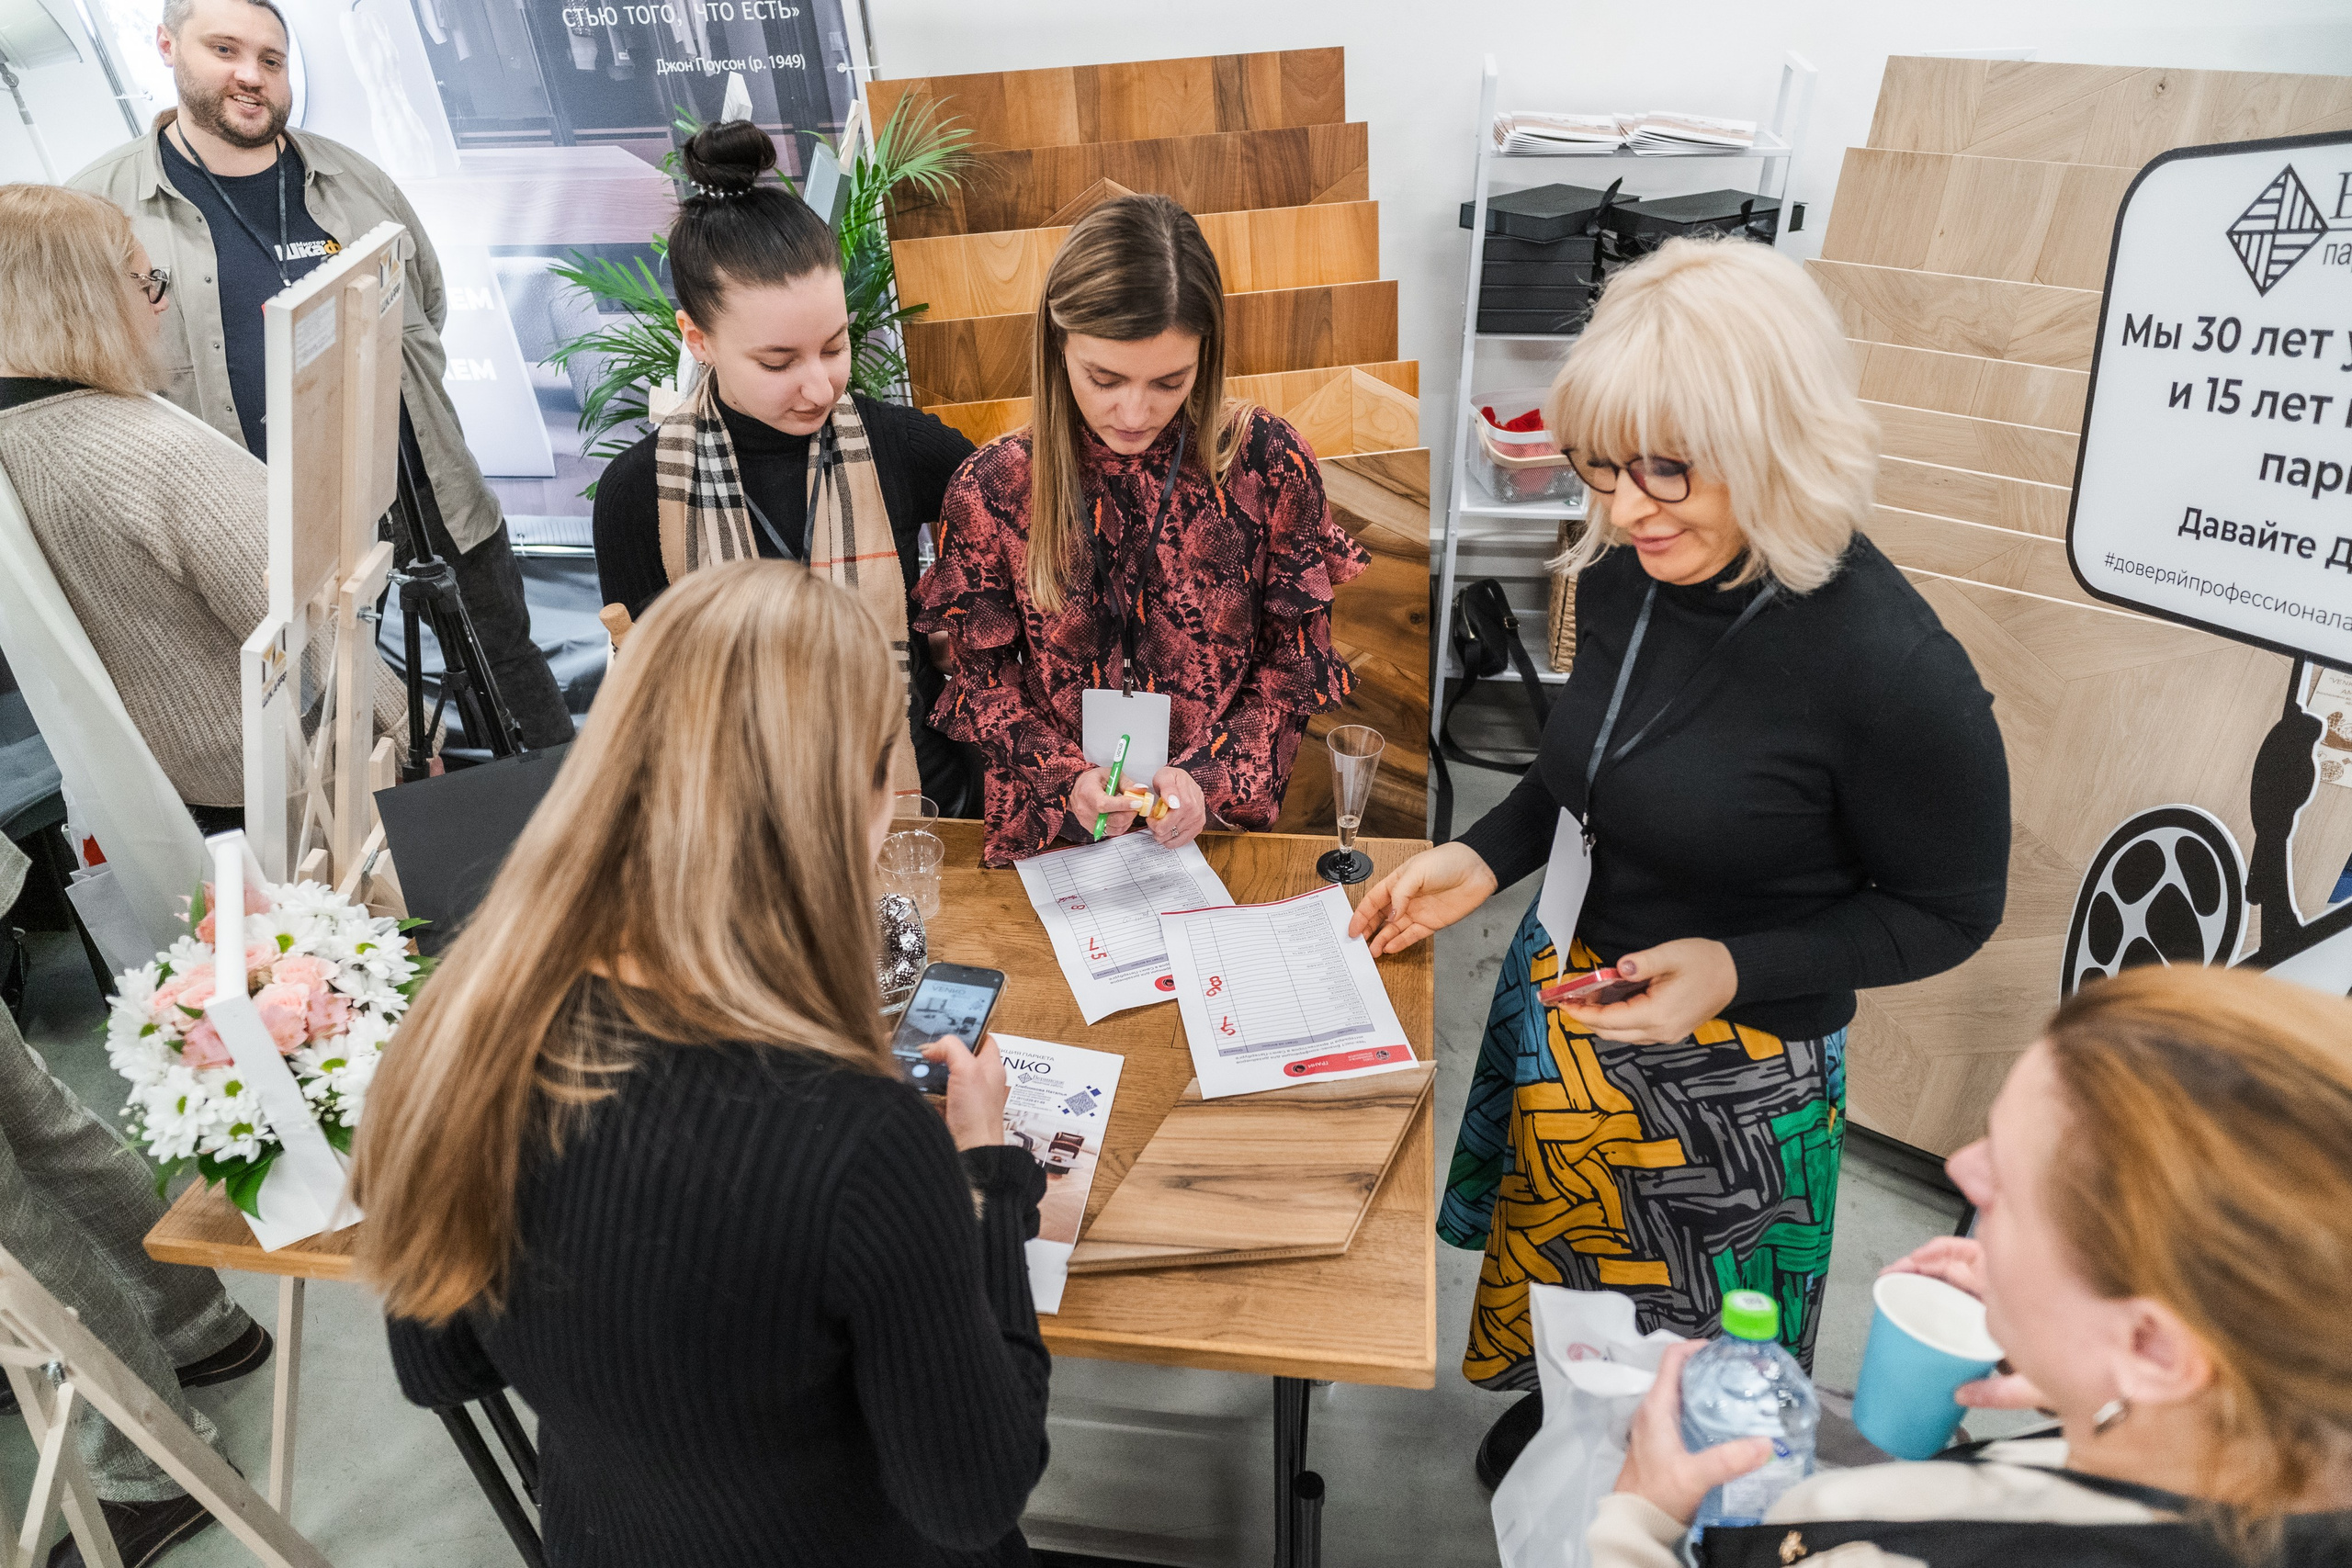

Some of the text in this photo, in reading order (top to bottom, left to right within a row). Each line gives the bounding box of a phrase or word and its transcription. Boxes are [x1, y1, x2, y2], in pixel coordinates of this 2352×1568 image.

[562, 1, 800, 27] СТЬЮ ТОГО, ЧТО ЕСТЬ»
[656, 53, 806, 75] Джон Поусон (р. 1949)
[2323, 243, 2352, 274] па
[2122, 313, 2182, 349] Мы
[2192, 316, 2242, 354] 30
[2251, 327, 2335, 359] лет
[2168, 381, 2193, 410] и
[2207, 377, 2243, 415] 15
[2251, 390, 2334, 424] лет
[2177, 506, 2316, 559] Давайте
[2104, 551, 2352, 631] #доверяйпрофессионала
[1023, 1052, 1055, 1061] ПАРКЕТА
